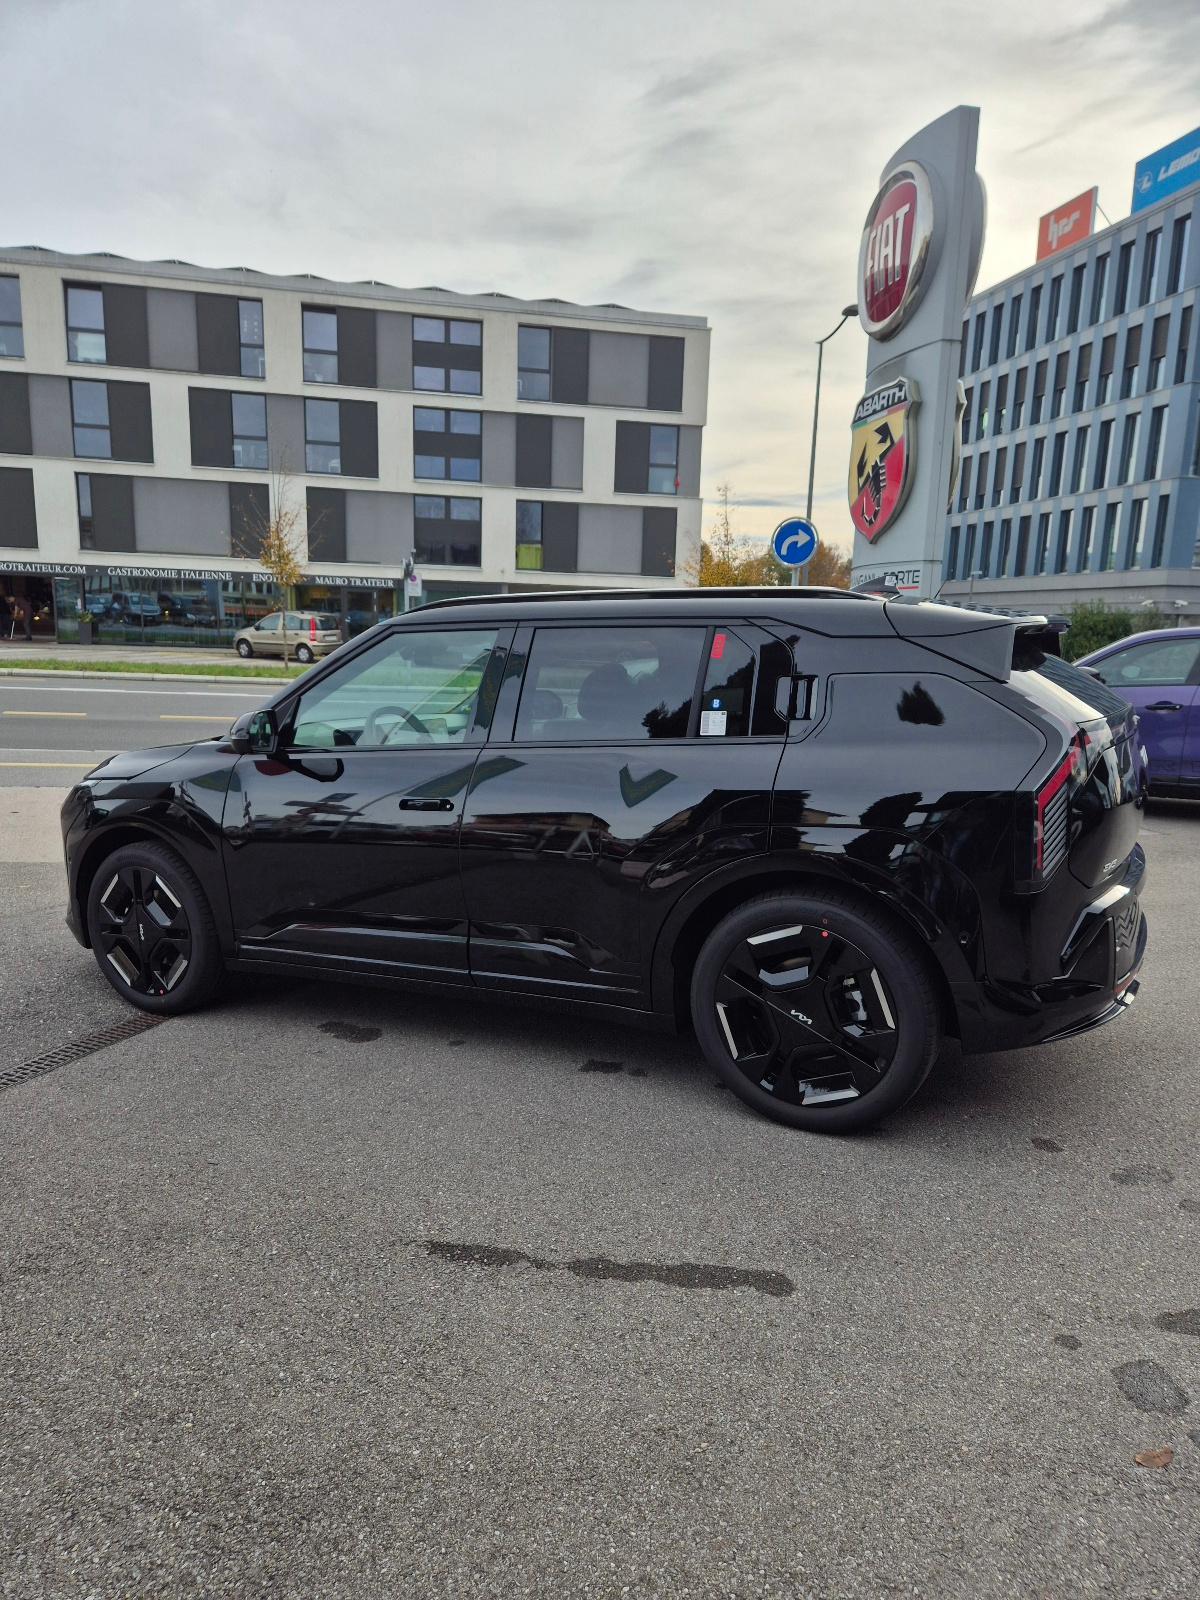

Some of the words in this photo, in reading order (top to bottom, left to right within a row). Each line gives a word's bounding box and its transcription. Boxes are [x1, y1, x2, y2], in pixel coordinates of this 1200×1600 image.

[866, 203, 910, 302] FIAT
[854, 386, 906, 421] ABARTH
[107, 567, 178, 578] GASTRONOMIE
[180, 569, 233, 581] ITALIENNE
[315, 576, 348, 585] MAURO
[351, 578, 394, 588] TRAITEUR
